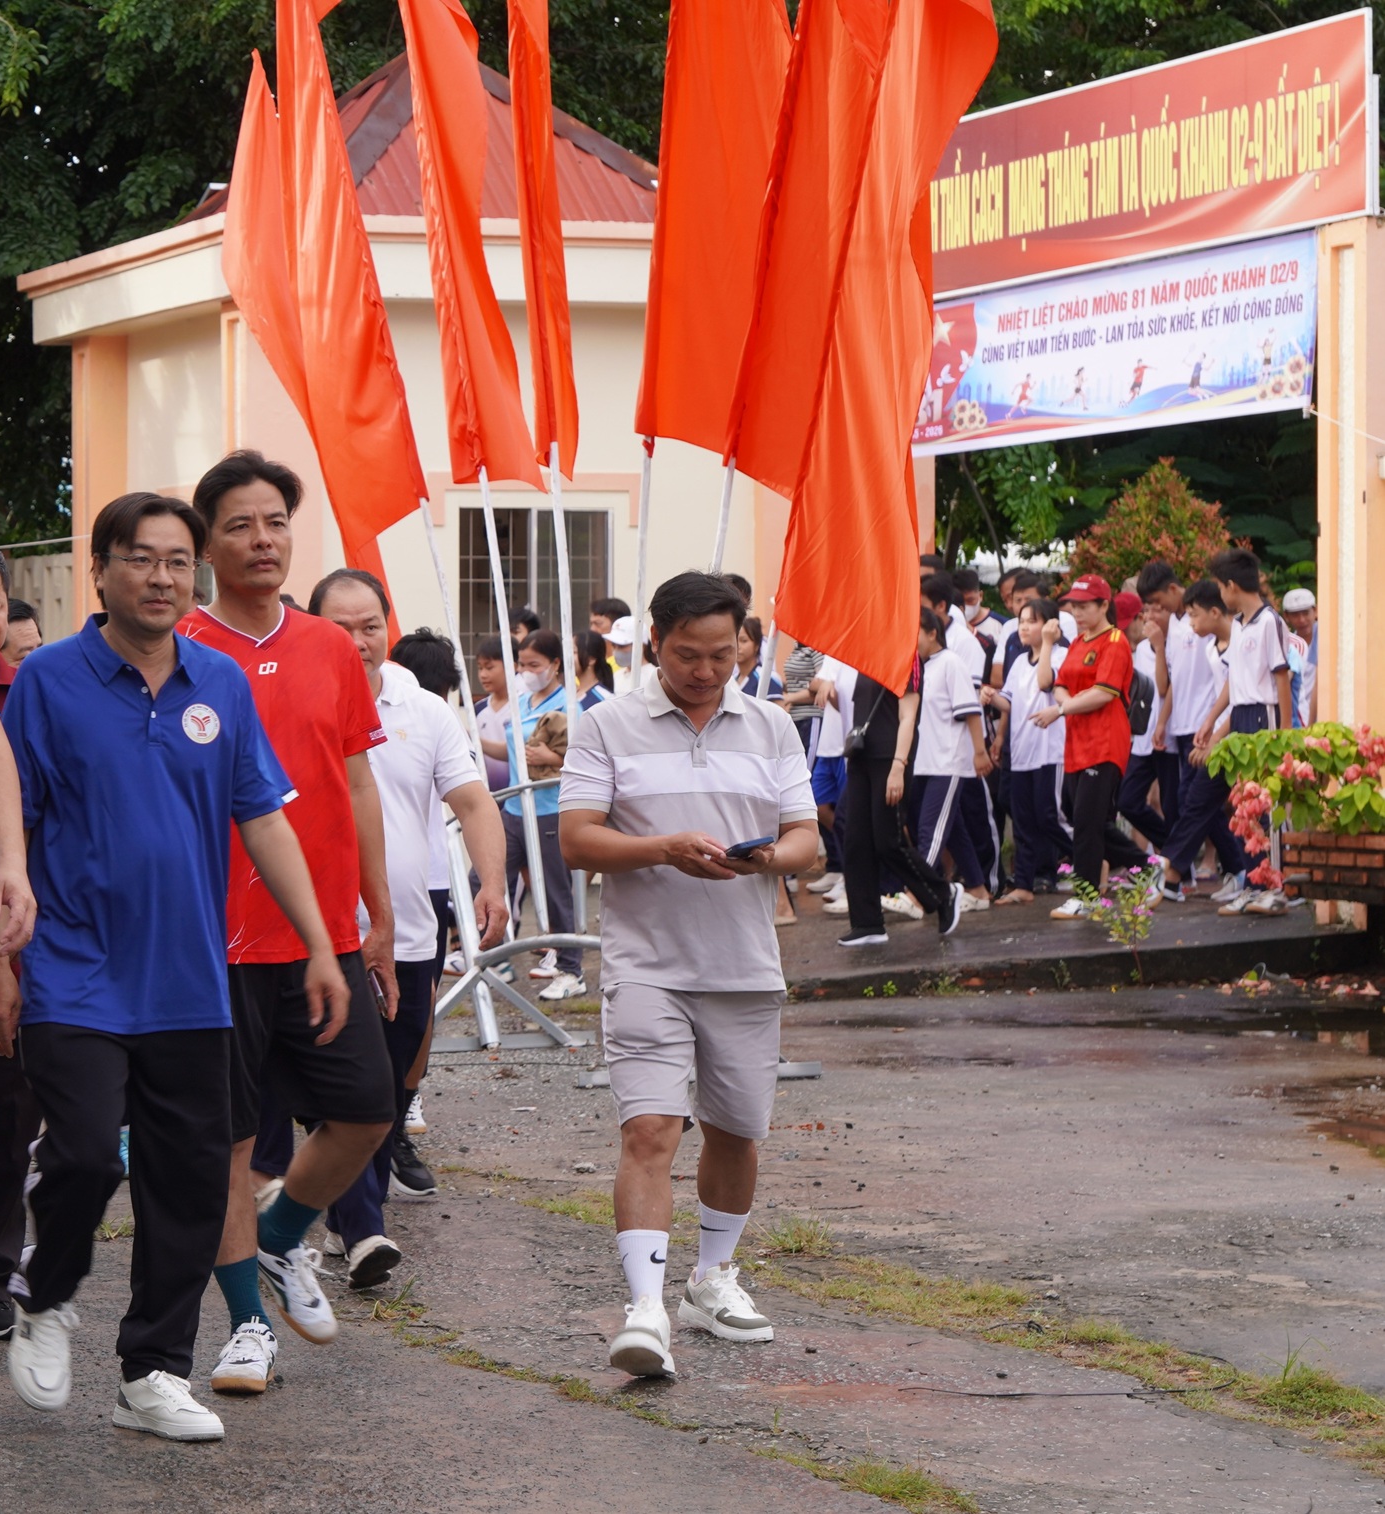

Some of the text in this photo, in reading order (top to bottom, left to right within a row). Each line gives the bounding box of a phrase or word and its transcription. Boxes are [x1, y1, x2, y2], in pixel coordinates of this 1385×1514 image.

[940, 148, 971, 252] THẦN
[972, 152, 1004, 246] CÁCH
[1008, 153, 1046, 252] MẠNG
[1047, 131, 1089, 229] THÁNG
[1090, 122, 1119, 219] TÁM
[1120, 114, 1139, 213] VÀ
[1141, 94, 1178, 218] QUỐC
[1180, 96, 1229, 200] KHÁNH
[1231, 101, 1264, 190] 02-9
[1266, 63, 1295, 182] BẤT
[981, 343, 1005, 364] CÙNG
[1007, 338, 1026, 364] VIỆT
[1026, 337, 1047, 357] NAM
[1050, 328, 1070, 354] TIẾN
[1072, 325, 1097, 350] BƯỚC
[1105, 325, 1125, 344] LAN
[1147, 312, 1167, 337] SỨC
[1201, 302, 1220, 328] KẾT
[1222, 298, 1241, 324] NỐI
[1243, 296, 1272, 325] CỘNG
[1275, 288, 1304, 316] ĐỒNG
[997, 260, 1299, 335] NHIỆT LIỆT CHÀO MỪNG 81 NĂM QUỐC KHÁNH 02/9
